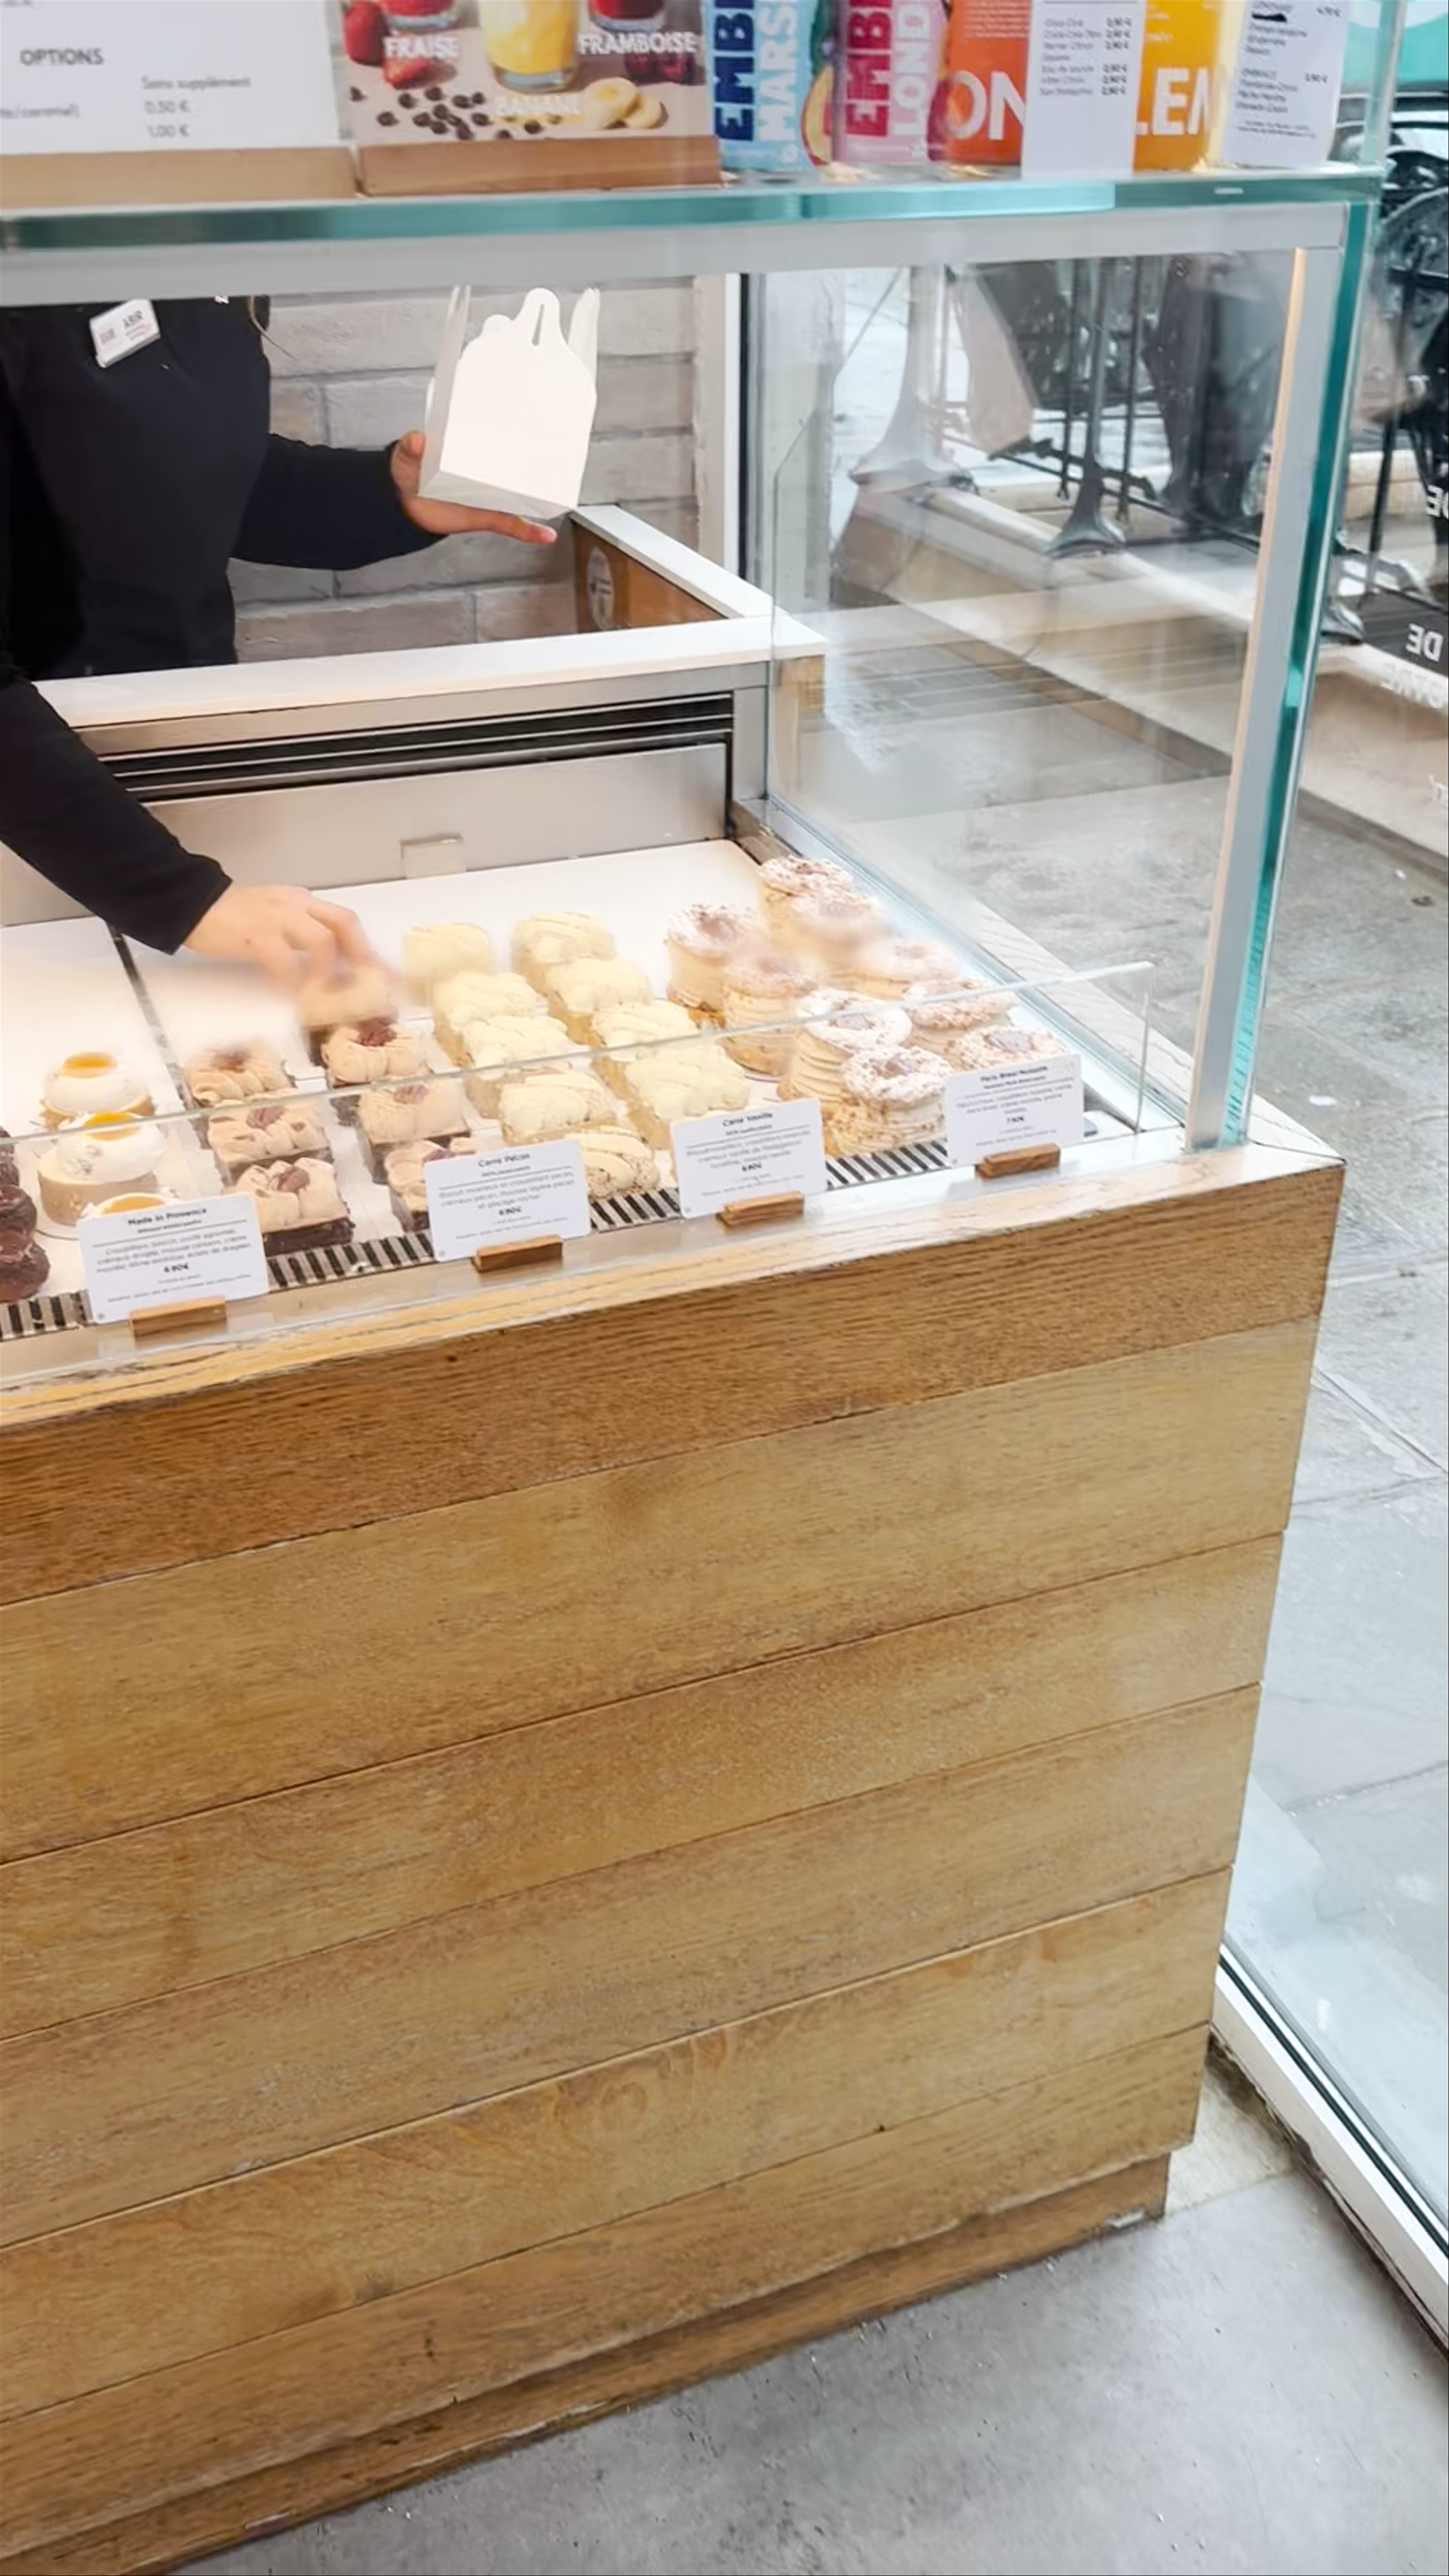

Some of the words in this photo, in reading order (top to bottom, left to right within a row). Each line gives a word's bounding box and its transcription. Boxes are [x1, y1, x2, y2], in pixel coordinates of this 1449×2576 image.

[383, 37, 460, 58] FRAISE
[579, 32, 699, 54] FRAMBOISE
[20, 49, 103, 66] OPTIONS
[714, 0, 754, 142] EMB
[846, 0, 891, 137] EMB
[128, 1216, 153, 1225] Made
